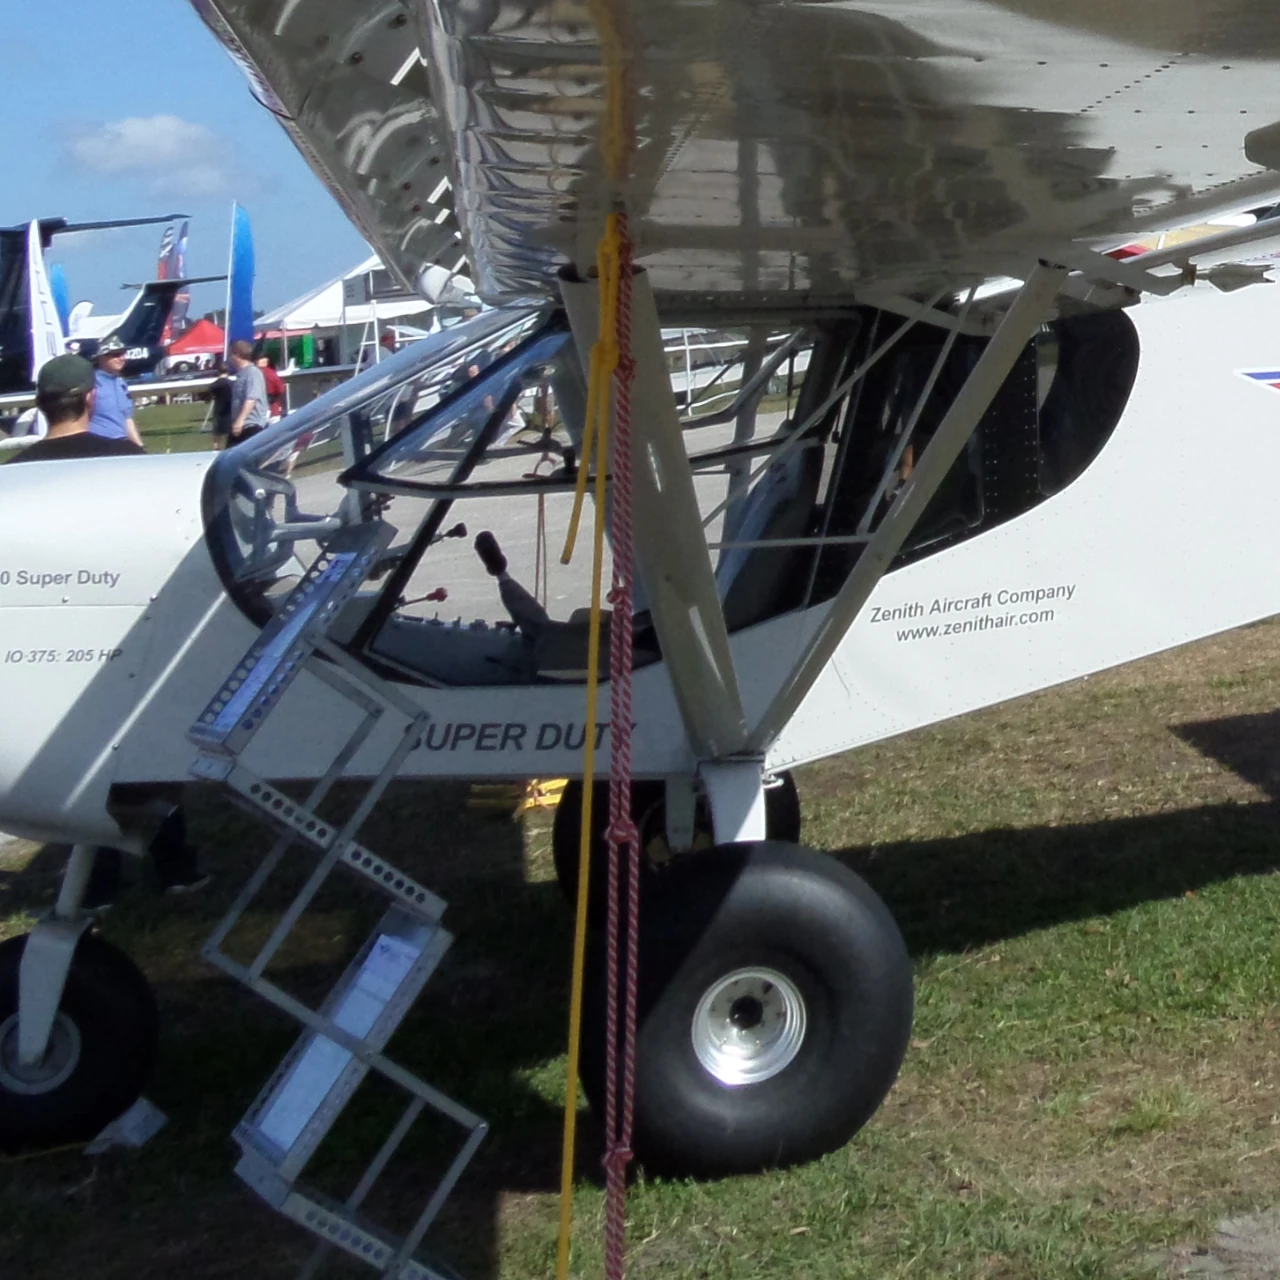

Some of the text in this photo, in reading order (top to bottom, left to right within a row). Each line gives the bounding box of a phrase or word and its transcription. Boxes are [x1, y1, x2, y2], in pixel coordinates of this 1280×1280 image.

[16, 569, 73, 589] Super
[77, 569, 121, 588] Duty
[870, 583, 1077, 624] Zenith Aircraft Company
[896, 608, 1056, 643] www.zenithair.com
[66, 648, 95, 663] 205
[98, 648, 124, 663] HP
